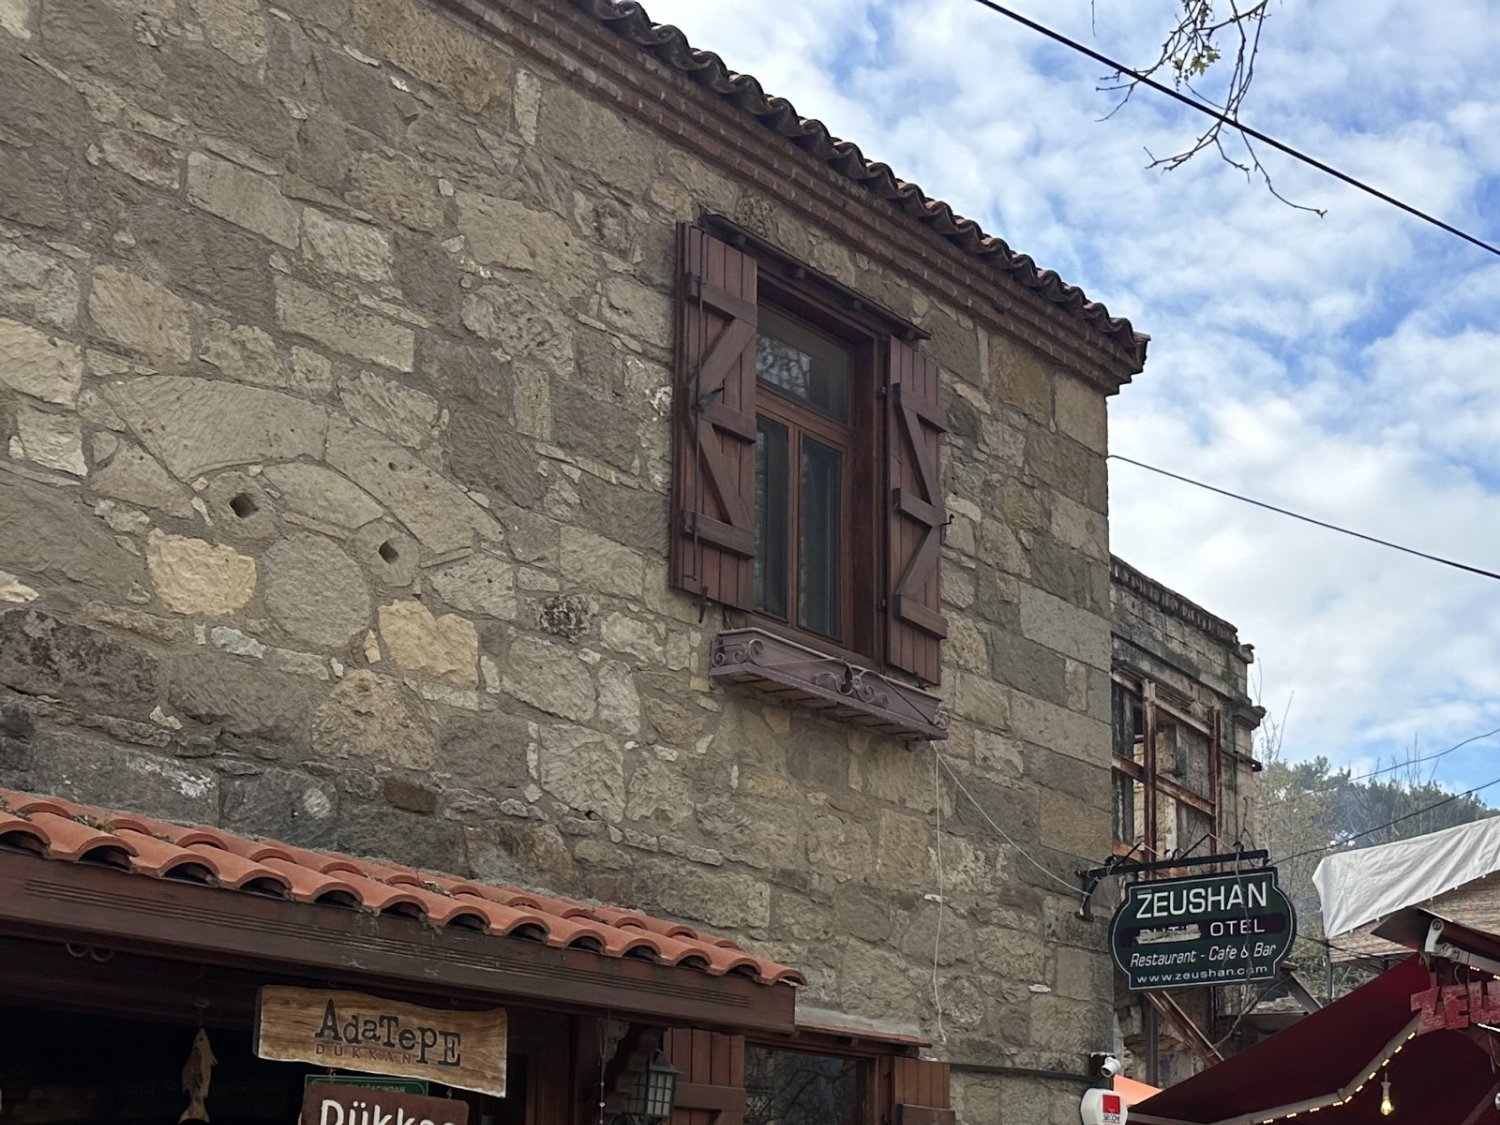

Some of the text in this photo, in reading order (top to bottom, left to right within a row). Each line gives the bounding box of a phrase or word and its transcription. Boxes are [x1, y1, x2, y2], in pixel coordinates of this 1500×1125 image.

[1136, 882, 1267, 919] ZEUSHAN
[1210, 919, 1265, 936] OTEL
[1130, 949, 1197, 968] Restaurant
[1208, 945, 1236, 961] Cafe
[1253, 942, 1276, 957] Bar
